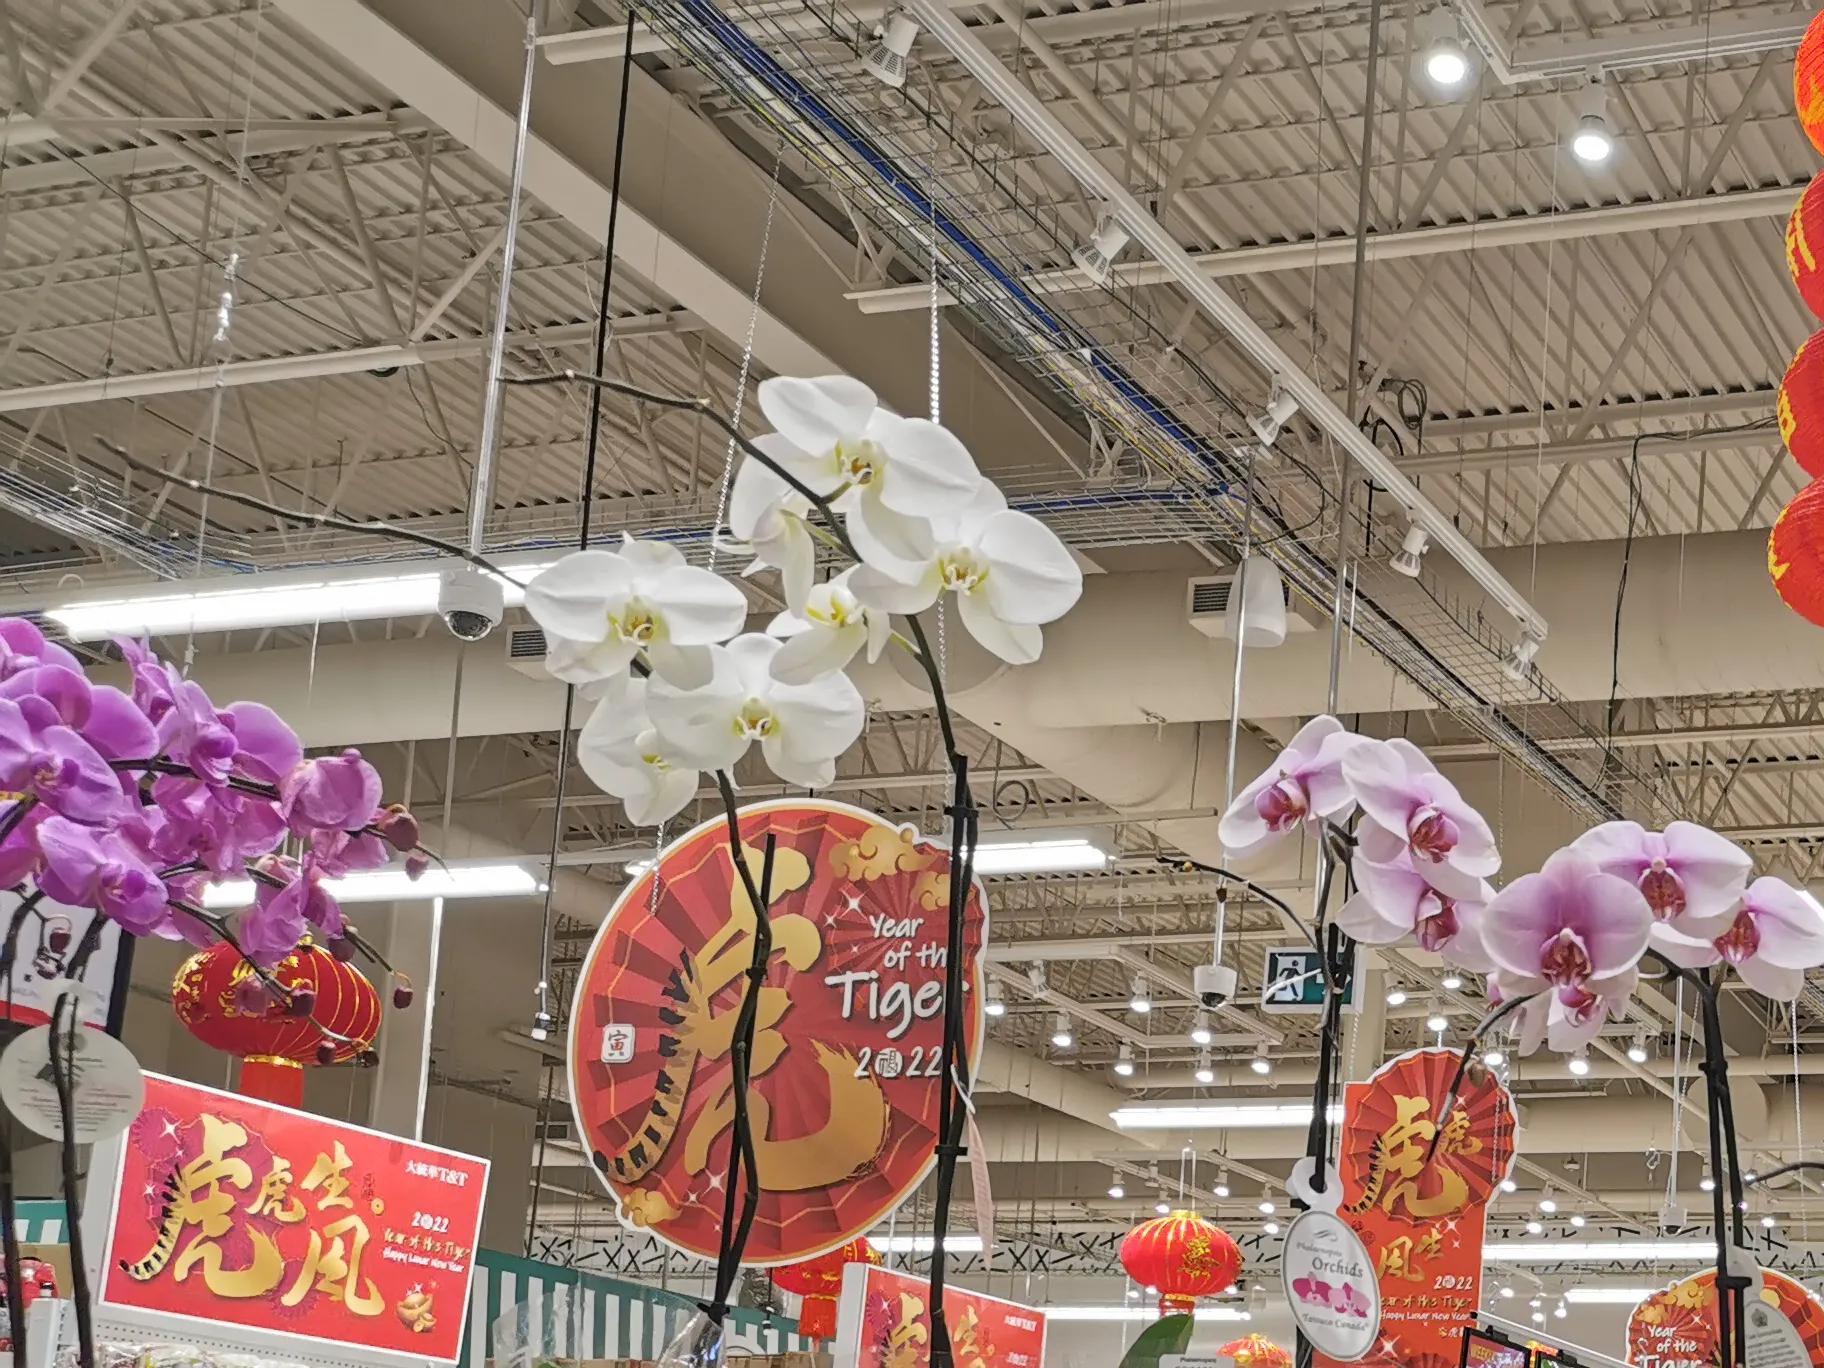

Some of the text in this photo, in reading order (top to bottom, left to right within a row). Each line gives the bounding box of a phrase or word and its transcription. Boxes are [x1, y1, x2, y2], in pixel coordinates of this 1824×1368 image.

[869, 914, 924, 939] Year
[883, 940, 950, 971] of th
[824, 968, 970, 1040] Tige
[1311, 1256, 1364, 1279] Orchids
[1648, 1324, 1678, 1339] Year
[1656, 1337, 1698, 1353] of the
